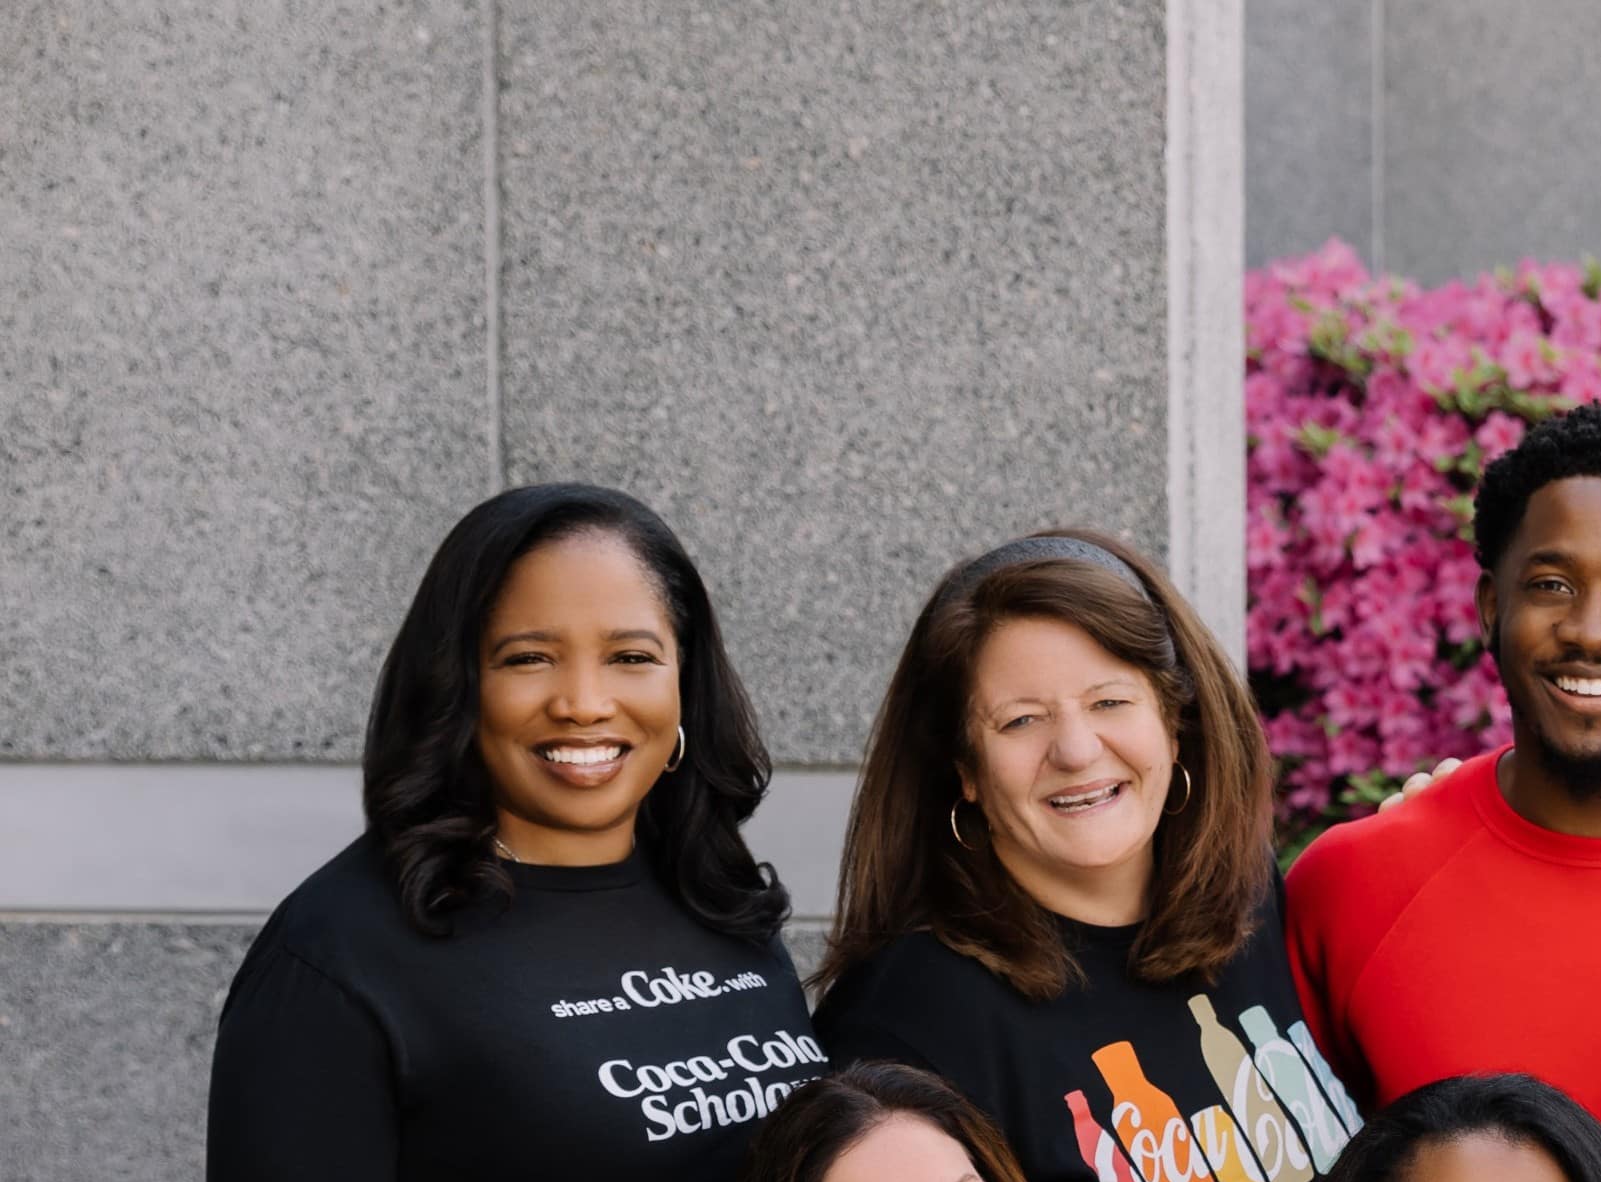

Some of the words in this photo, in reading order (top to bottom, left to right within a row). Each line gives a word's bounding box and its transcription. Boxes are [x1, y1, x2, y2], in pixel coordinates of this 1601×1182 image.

[551, 997, 613, 1017] share
[612, 996, 631, 1010] a
[725, 971, 767, 992] with
[598, 1030, 829, 1098] Coca-Cola
[641, 1076, 822, 1142] Schola
